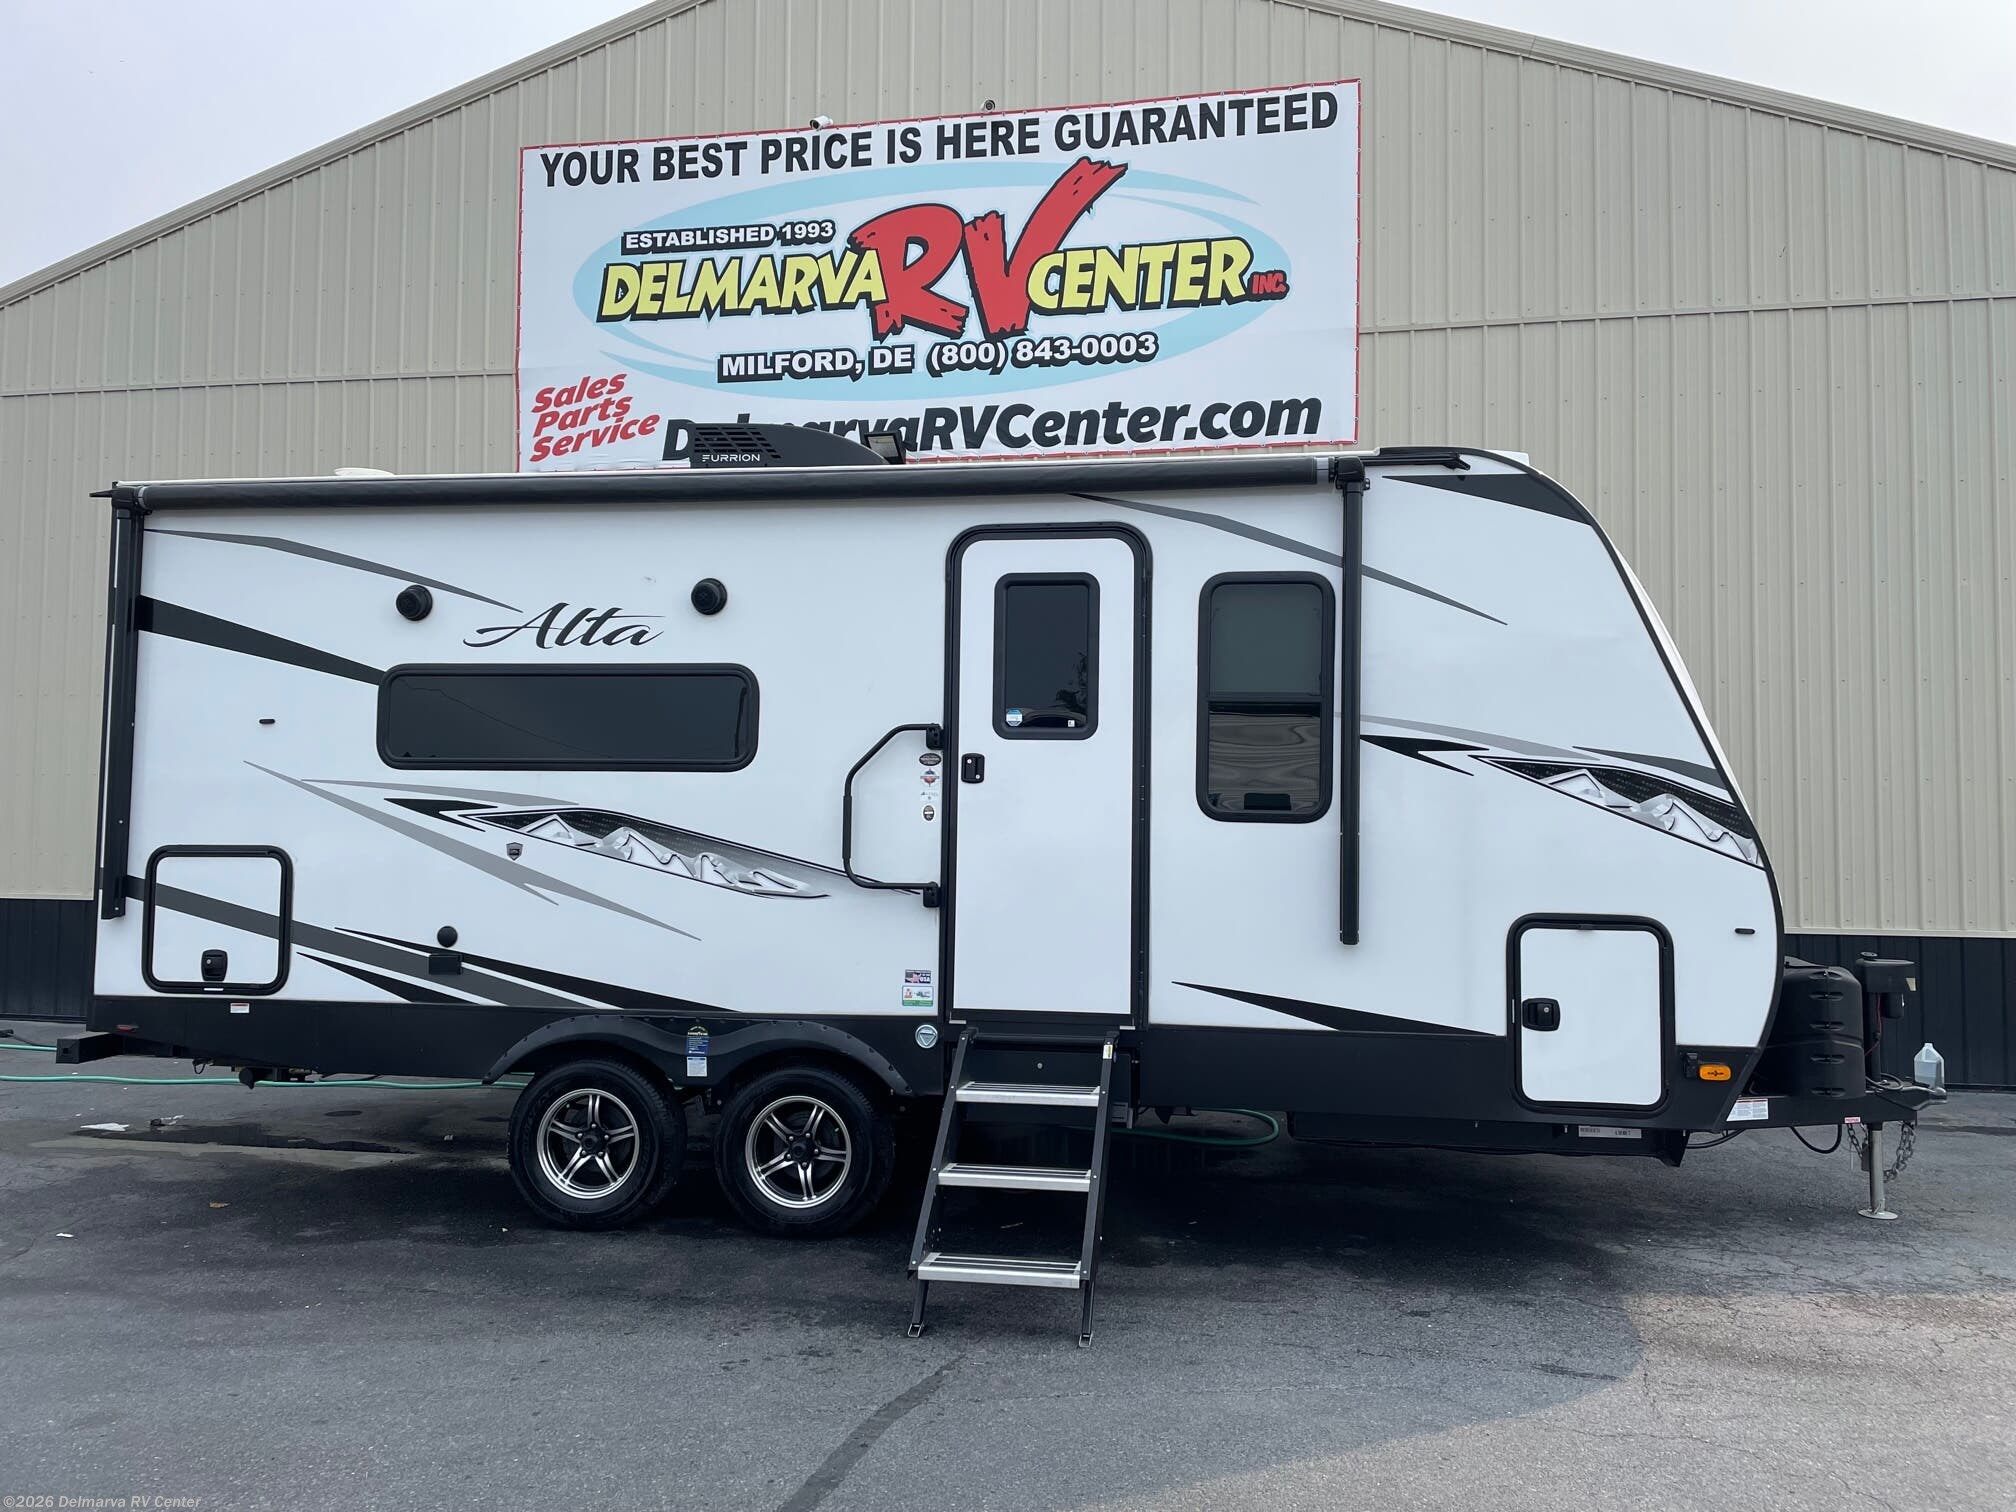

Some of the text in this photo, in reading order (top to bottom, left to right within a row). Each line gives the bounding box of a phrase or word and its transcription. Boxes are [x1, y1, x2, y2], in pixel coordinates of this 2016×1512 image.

[540, 91, 1338, 187] YOUR BEST PRICE IS HERE GUARANTEED
[598, 248, 889, 320] DELMARVA
[848, 156, 1128, 342] RV
[1027, 237, 1252, 313] CENTER
[626, 222, 834, 249] ESTABLISHED 1993
[722, 334, 1157, 378] MILFORD, DE (800) 843-0003
[531, 373, 628, 413] Sales
[529, 414, 661, 462] Service
[533, 396, 634, 438] Parts
[701, 453, 761, 463] FURRION
[463, 601, 667, 650] Alta
